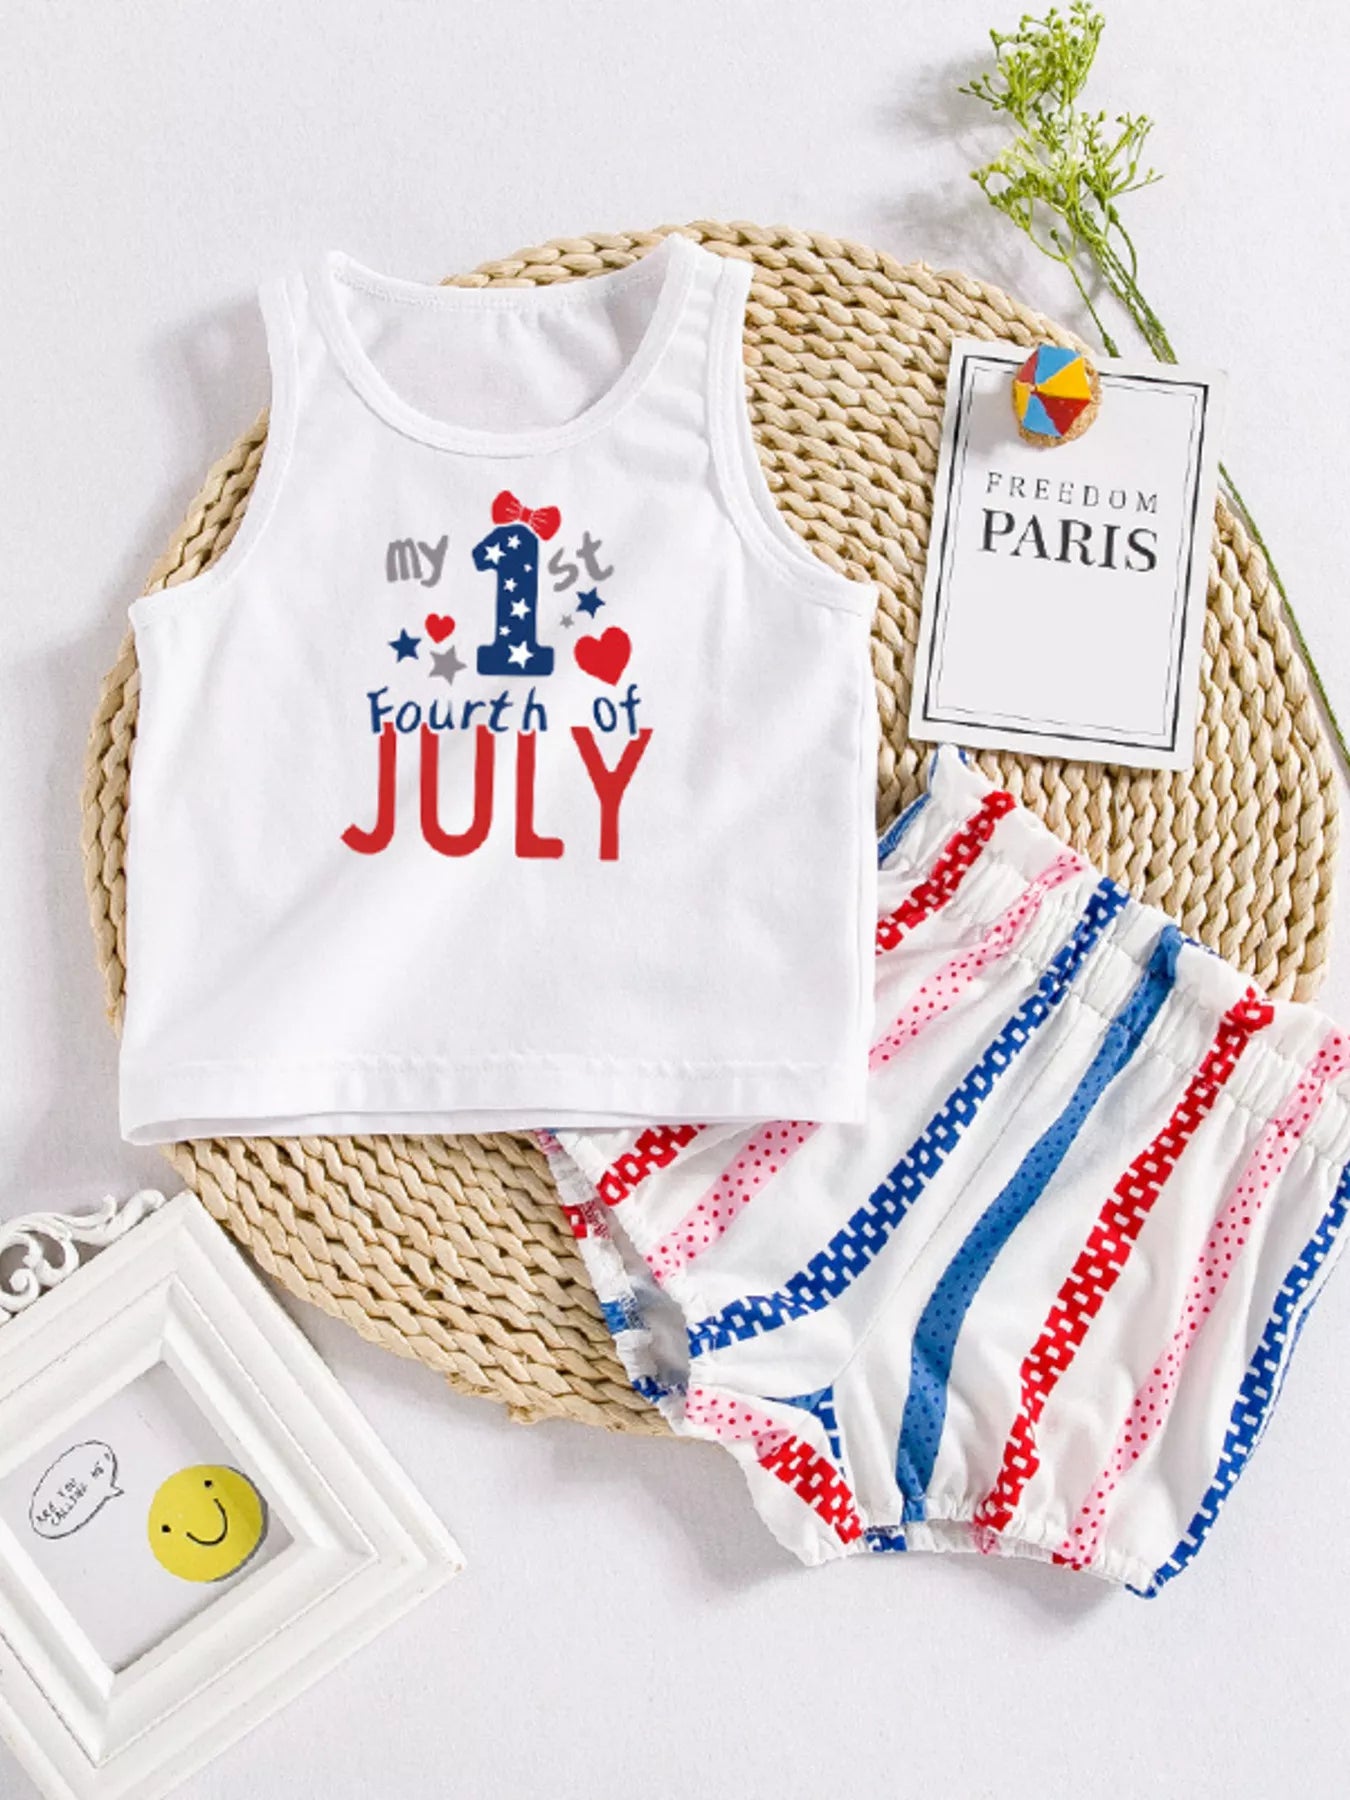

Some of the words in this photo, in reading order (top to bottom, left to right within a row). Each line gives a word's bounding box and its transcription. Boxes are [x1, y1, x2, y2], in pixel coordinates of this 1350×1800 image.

[985, 472, 1158, 513] FREEDOM
[386, 534, 448, 587] my
[979, 507, 1158, 572] PARIS
[367, 687, 547, 734] Fourth
[341, 721, 653, 861] JULY
